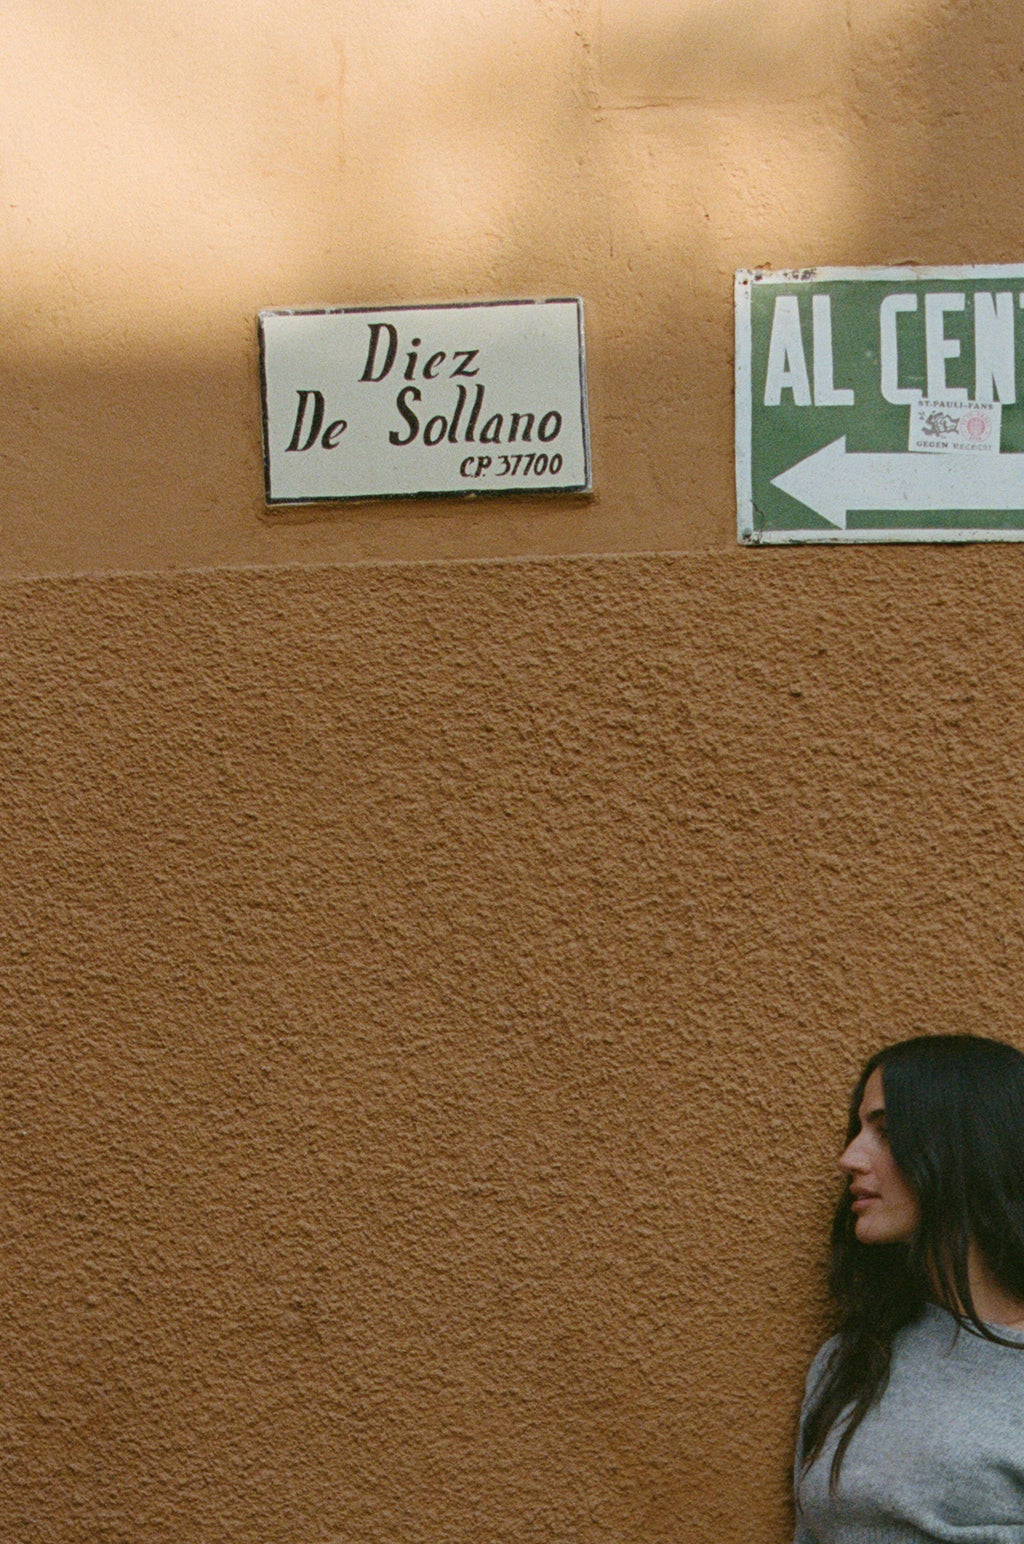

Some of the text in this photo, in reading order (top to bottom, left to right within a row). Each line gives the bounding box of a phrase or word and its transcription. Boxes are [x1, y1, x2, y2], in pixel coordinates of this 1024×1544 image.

[358, 322, 480, 382] Diez
[764, 294, 854, 406] AL
[285, 384, 562, 452] De Sollano
[916, 440, 948, 449] GEGEN
[495, 453, 563, 476] 37700
